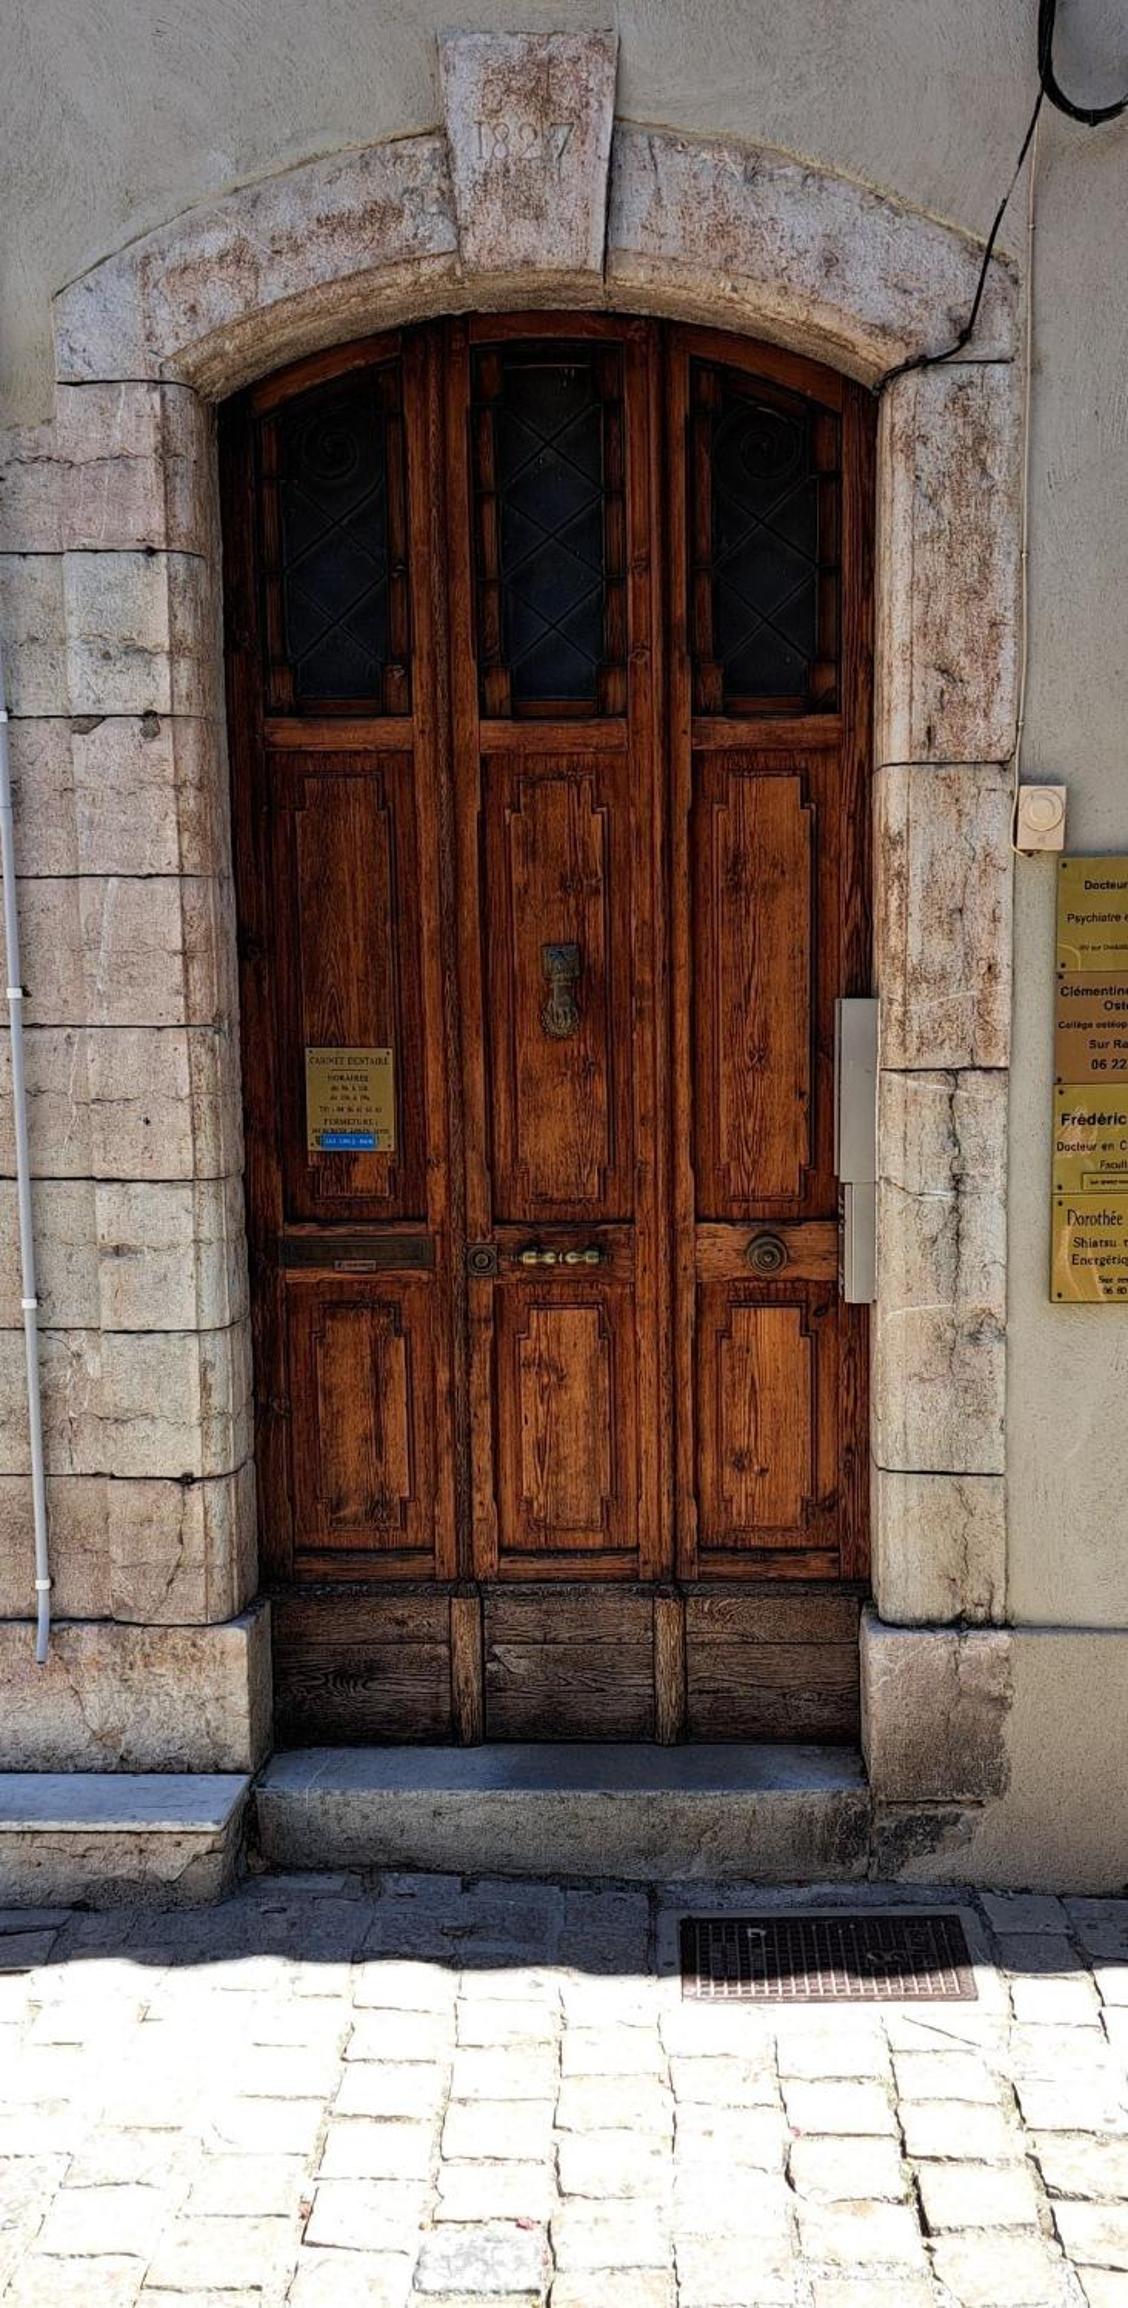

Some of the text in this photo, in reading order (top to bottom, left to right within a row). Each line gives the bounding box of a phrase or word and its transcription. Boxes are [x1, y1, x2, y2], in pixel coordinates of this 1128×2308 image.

[474, 120, 575, 160] 1827
[1084, 880, 1128, 890] Docteur
[1067, 912, 1121, 925] Psychiatre
[1089, 1039, 1109, 1049] Sur
[1091, 1059, 1128, 1070] 06 22
[1060, 1111, 1128, 1127] Frédéric
[1056, 1141, 1098, 1152] Docteur
[1101, 1142, 1115, 1151] en
[1066, 1208, 1124, 1227] Dorothée
[1073, 1236, 1117, 1248] Shiatsu
